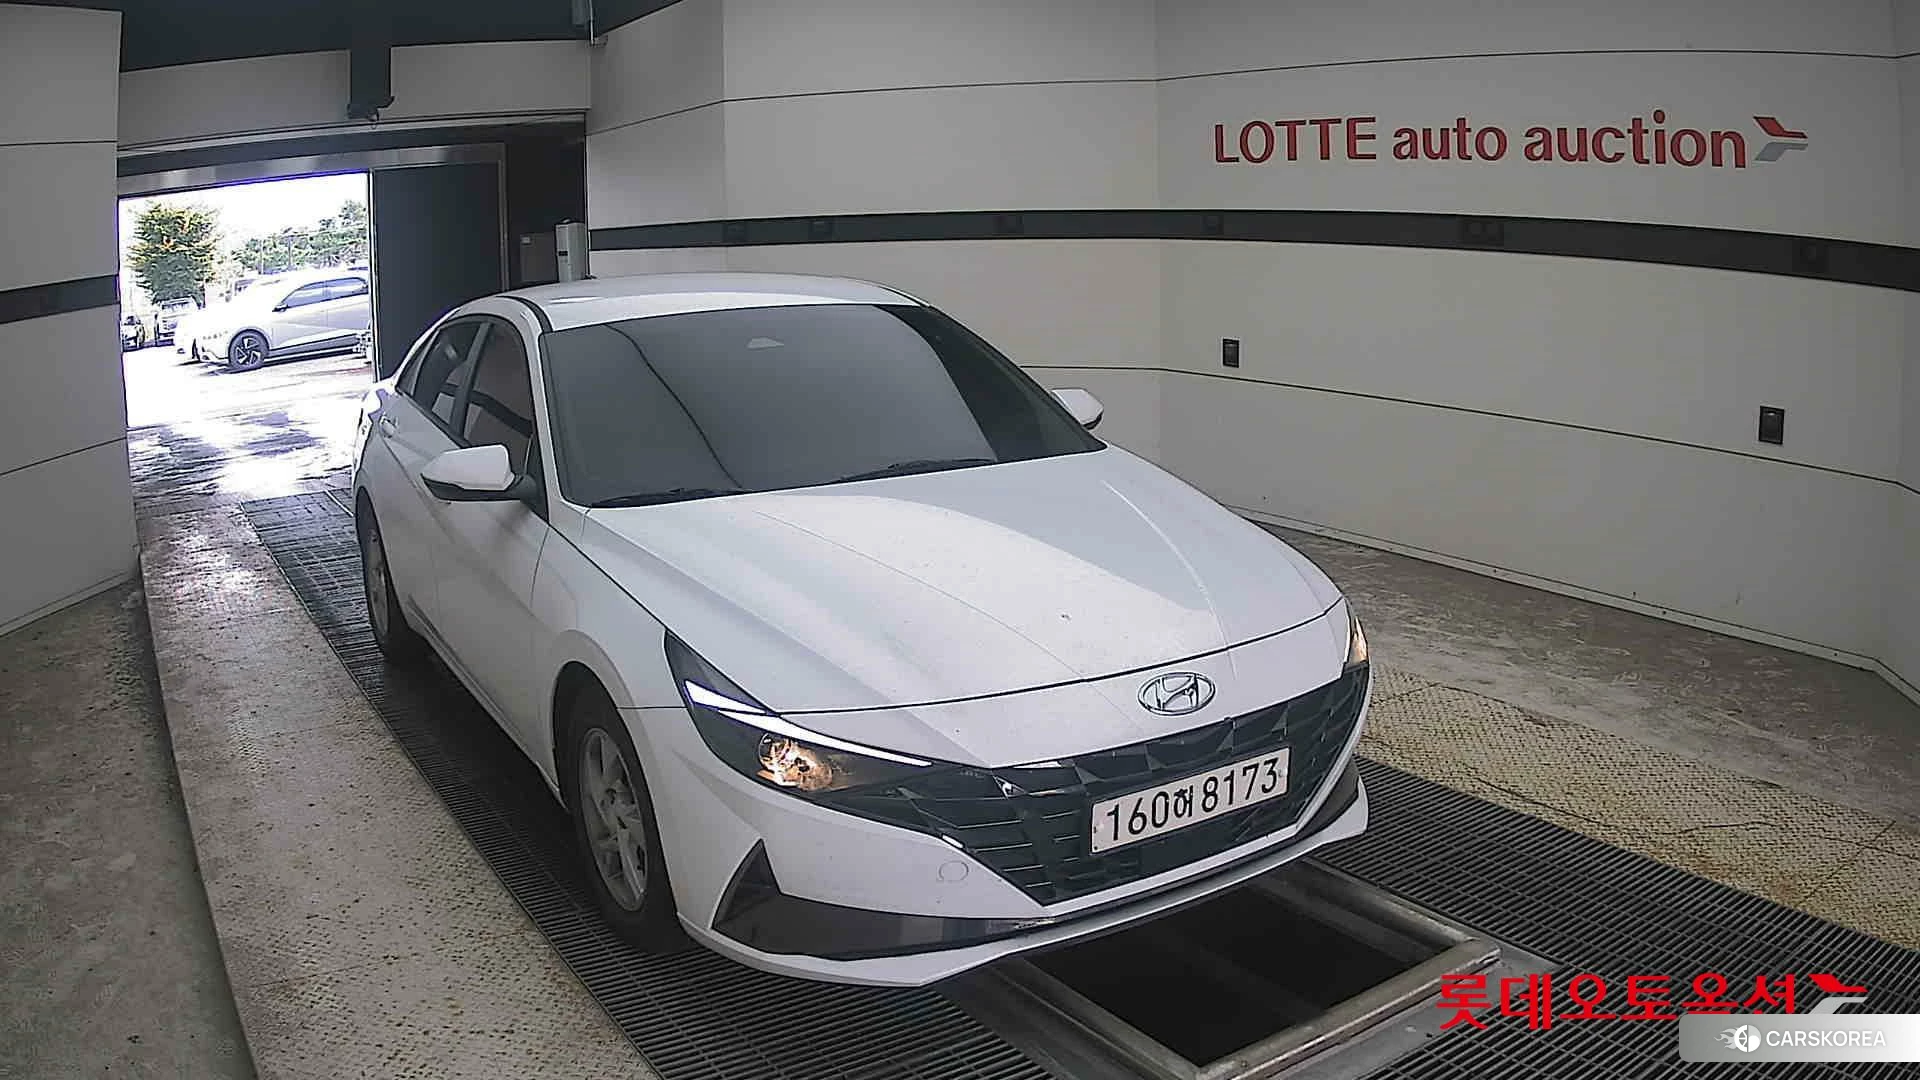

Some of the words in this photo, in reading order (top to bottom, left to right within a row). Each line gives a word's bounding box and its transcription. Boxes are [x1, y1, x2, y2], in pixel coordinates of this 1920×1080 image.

[1214, 117, 1377, 163] LOTTE
[1393, 117, 1508, 162] auto
[1524, 110, 1747, 168] auction
[1106, 784, 1194, 841] 160허
[1201, 757, 1279, 813] 8173
